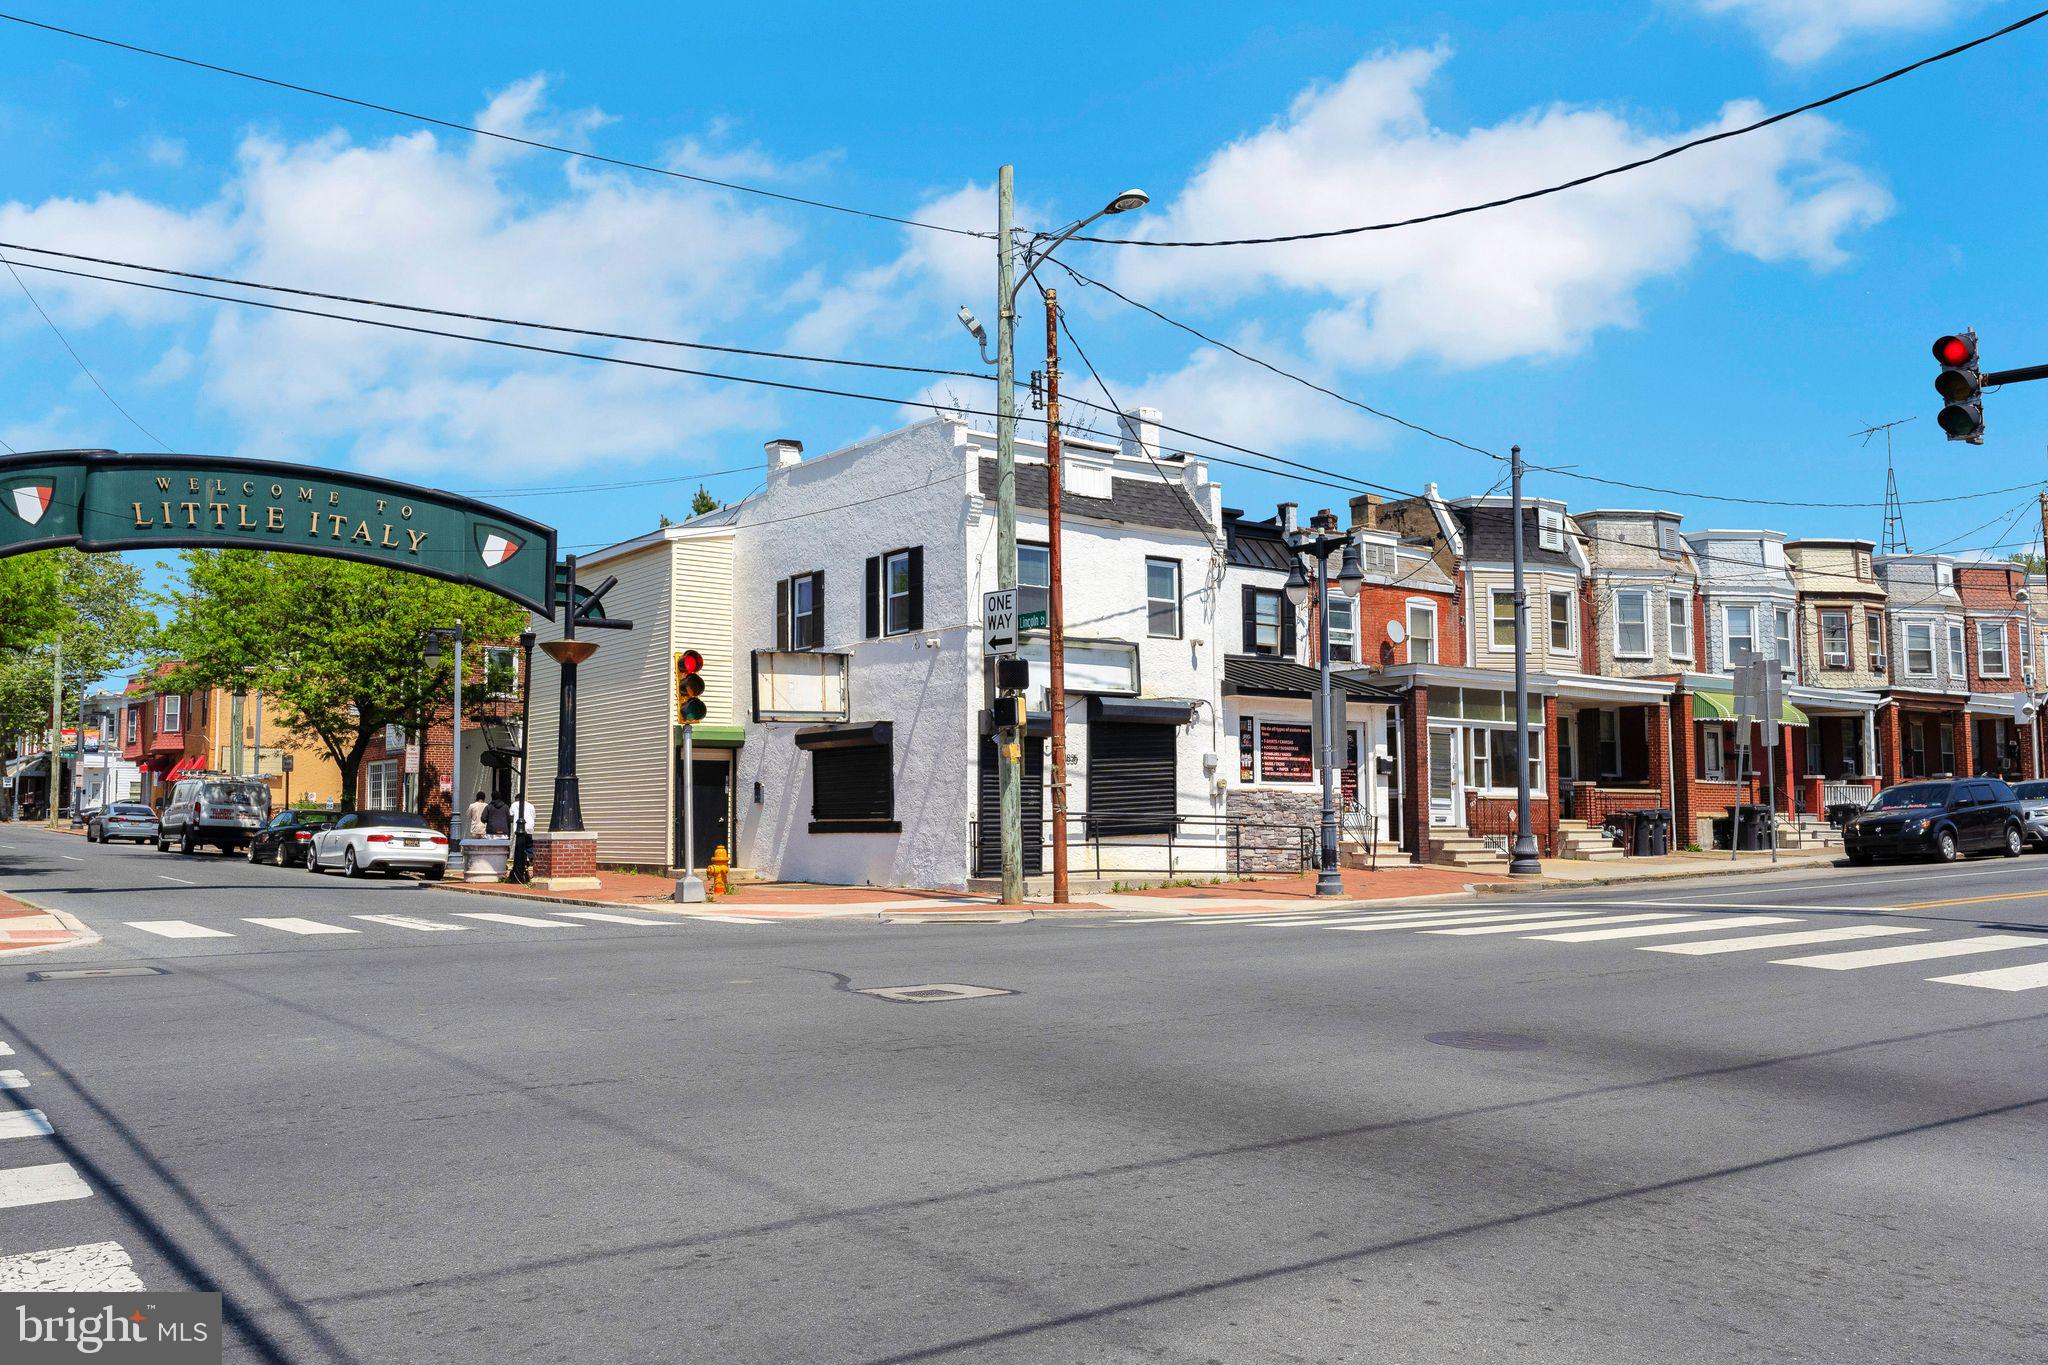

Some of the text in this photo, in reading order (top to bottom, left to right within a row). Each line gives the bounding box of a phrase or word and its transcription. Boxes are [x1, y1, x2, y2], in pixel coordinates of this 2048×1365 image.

[156, 477, 413, 520] WELCOME TO
[132, 501, 428, 552] LITTLE ITALY
[988, 594, 1012, 612] ONE
[987, 612, 1013, 631] WAY
[1019, 614, 1039, 629] Lincoln
